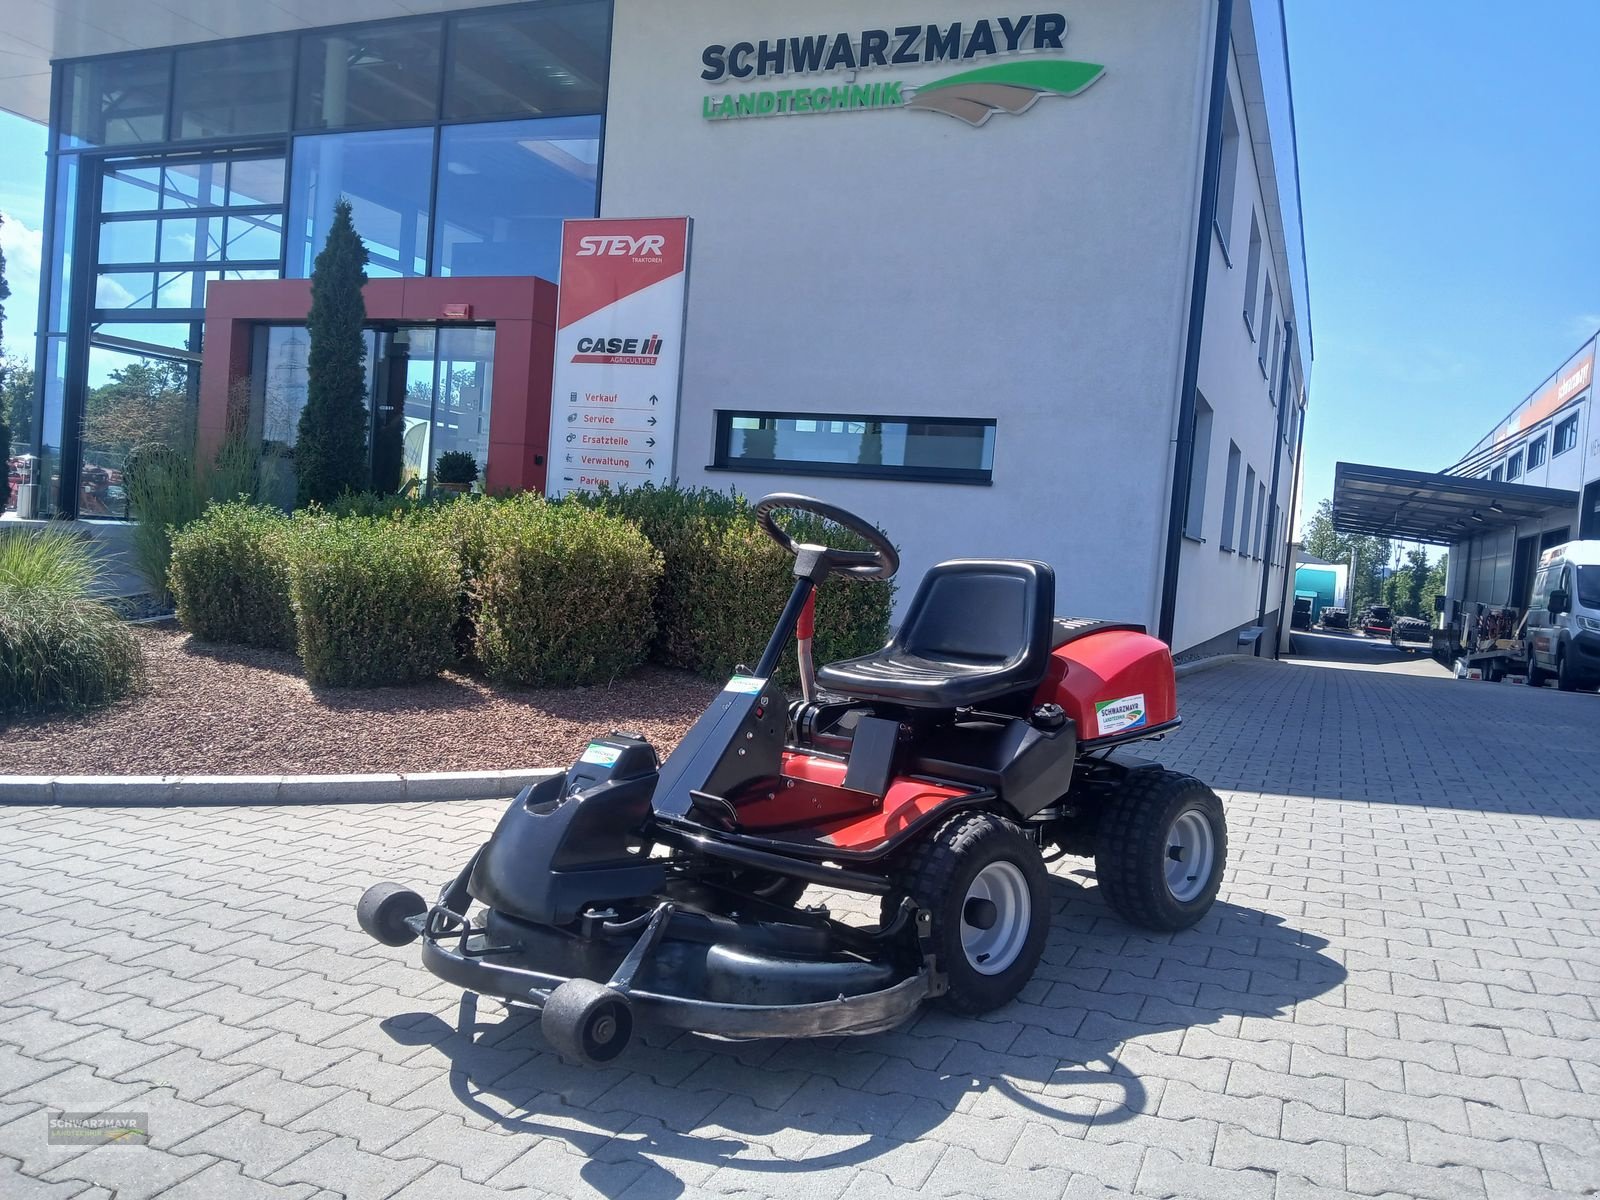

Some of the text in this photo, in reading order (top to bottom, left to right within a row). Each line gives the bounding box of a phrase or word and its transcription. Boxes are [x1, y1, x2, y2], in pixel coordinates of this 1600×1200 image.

[700, 13, 1068, 81] SCHWARZMAYR
[702, 81, 905, 120] LANDTECHNIK
[576, 235, 665, 256] STEYR
[577, 337, 638, 354] CASE
[609, 356, 655, 365] AGRICULTURE
[585, 393, 618, 402] Verkauf
[583, 414, 615, 424] Service
[582, 435, 629, 446] Ersatzteile
[581, 455, 630, 468] Verwaltung
[1101, 703, 1139, 716] SCHWARZMAYR
